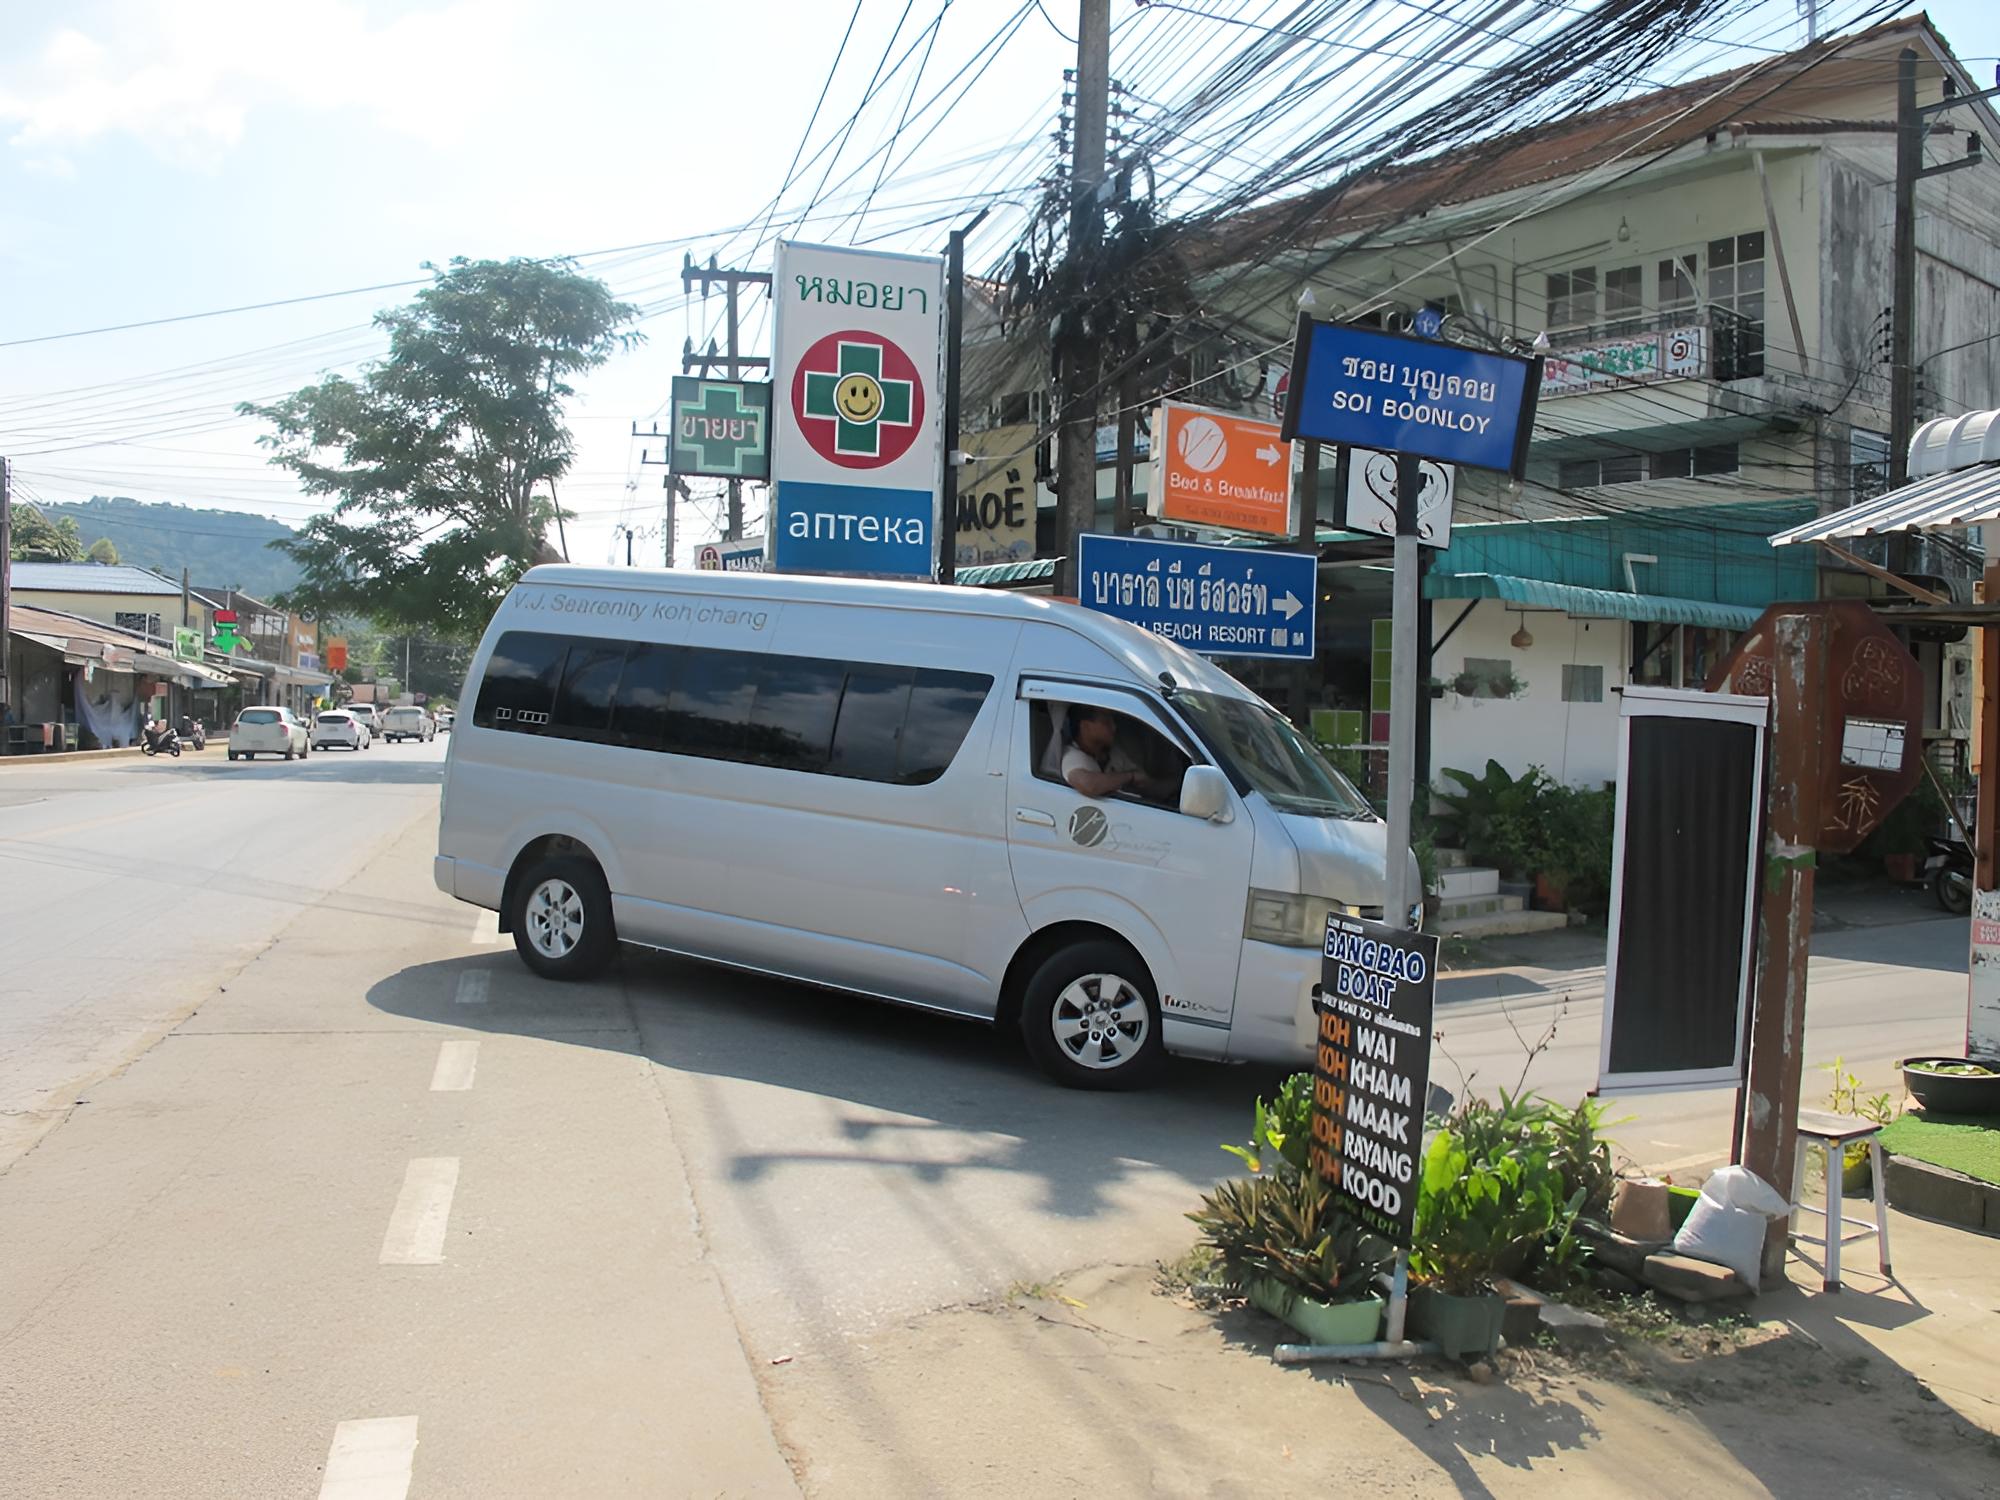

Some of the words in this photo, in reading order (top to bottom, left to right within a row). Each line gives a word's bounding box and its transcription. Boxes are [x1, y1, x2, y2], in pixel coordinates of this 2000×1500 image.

[795, 274, 928, 315] หมอยา
[1342, 356, 1395, 383] ซอย
[1401, 366, 1496, 403] บุญลอย
[1332, 390, 1373, 414] SOI
[1382, 398, 1491, 435] BOONLOY
[1203, 478, 1213, 493] &
[788, 511, 924, 545] аптека
[652, 602, 693, 621] koh
[697, 606, 768, 631] chang
[1153, 622, 1202, 641] BEACH
[1209, 626, 1266, 644] RESORT
[1337, 964, 1397, 1009] BOAT
[1320, 1010, 1350, 1048] KOH
[1357, 1025, 1396, 1066] WAI
[1318, 1043, 1348, 1082] KOH
[1350, 1058, 1411, 1107] KHAM
[1347, 1094, 1410, 1145] MAAK
[1344, 1129, 1412, 1183] RAYANG
[1342, 1163, 1401, 1216] KOOD
